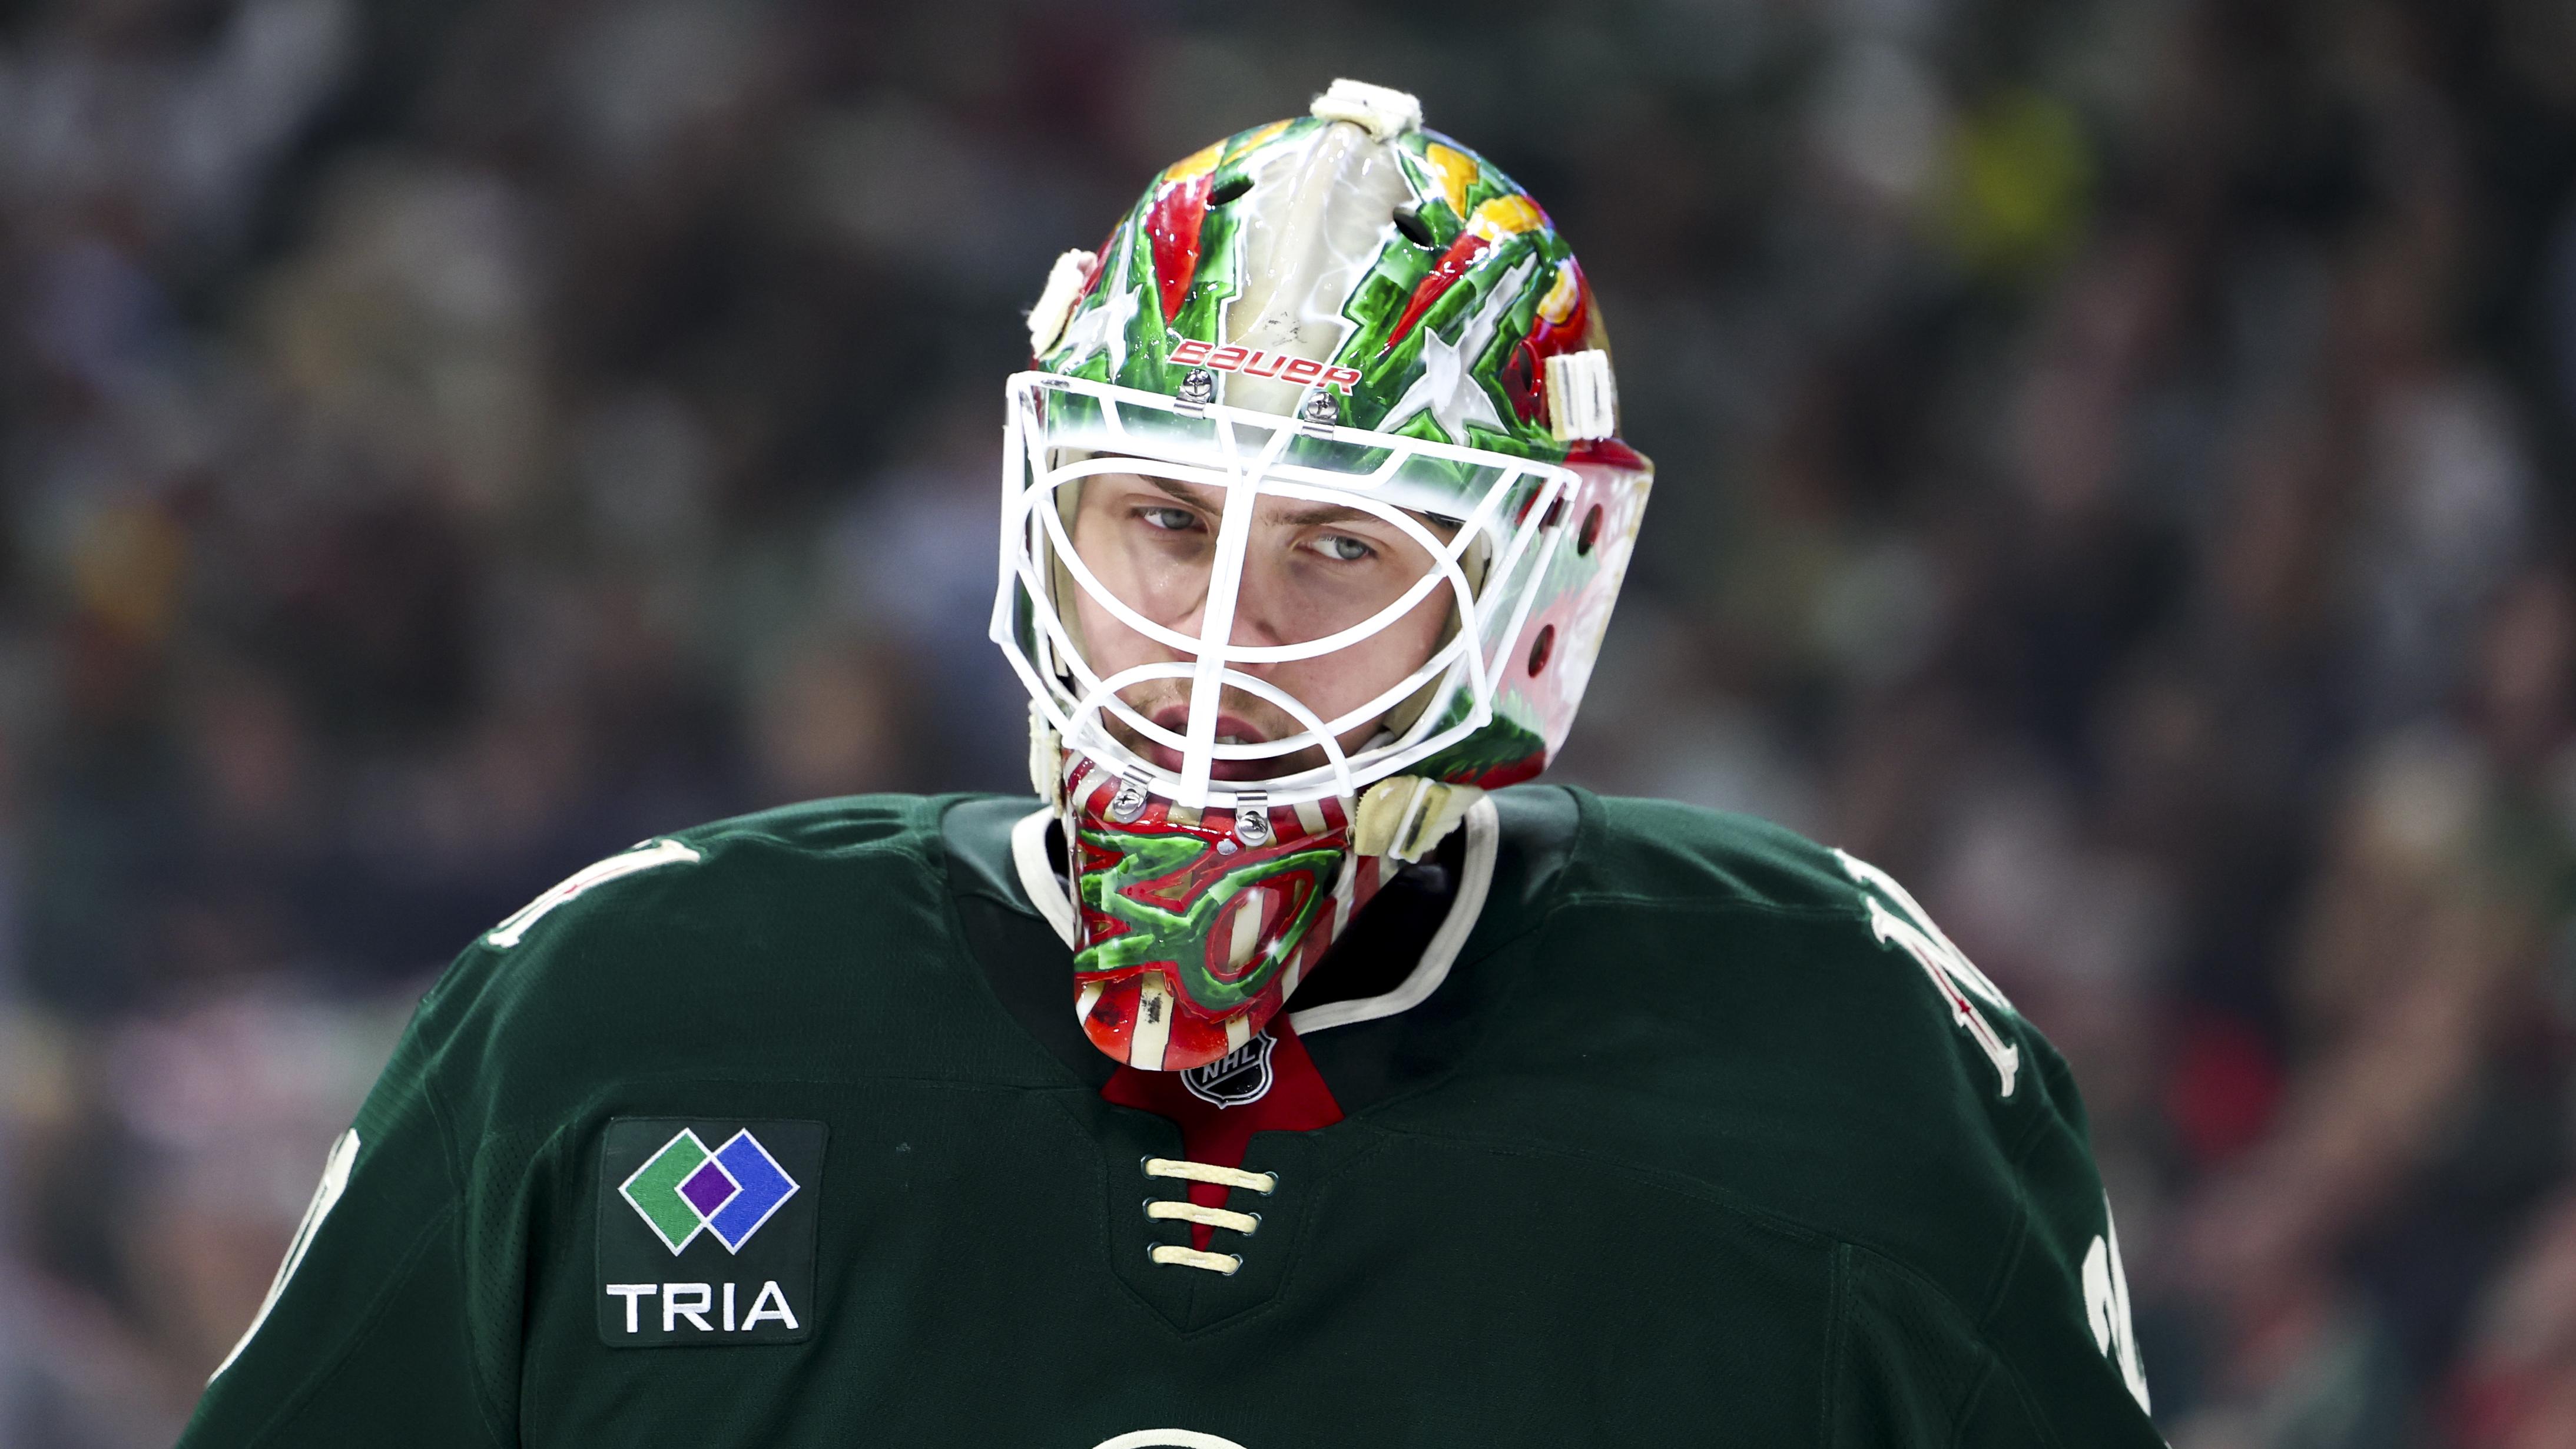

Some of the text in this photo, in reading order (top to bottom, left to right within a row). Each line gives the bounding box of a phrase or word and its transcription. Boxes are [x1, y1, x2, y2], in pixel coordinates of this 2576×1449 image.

[1169, 340, 1361, 394] BAUER
[1202, 1045, 1256, 1084] NHL
[606, 1280, 800, 1333] TRIA
